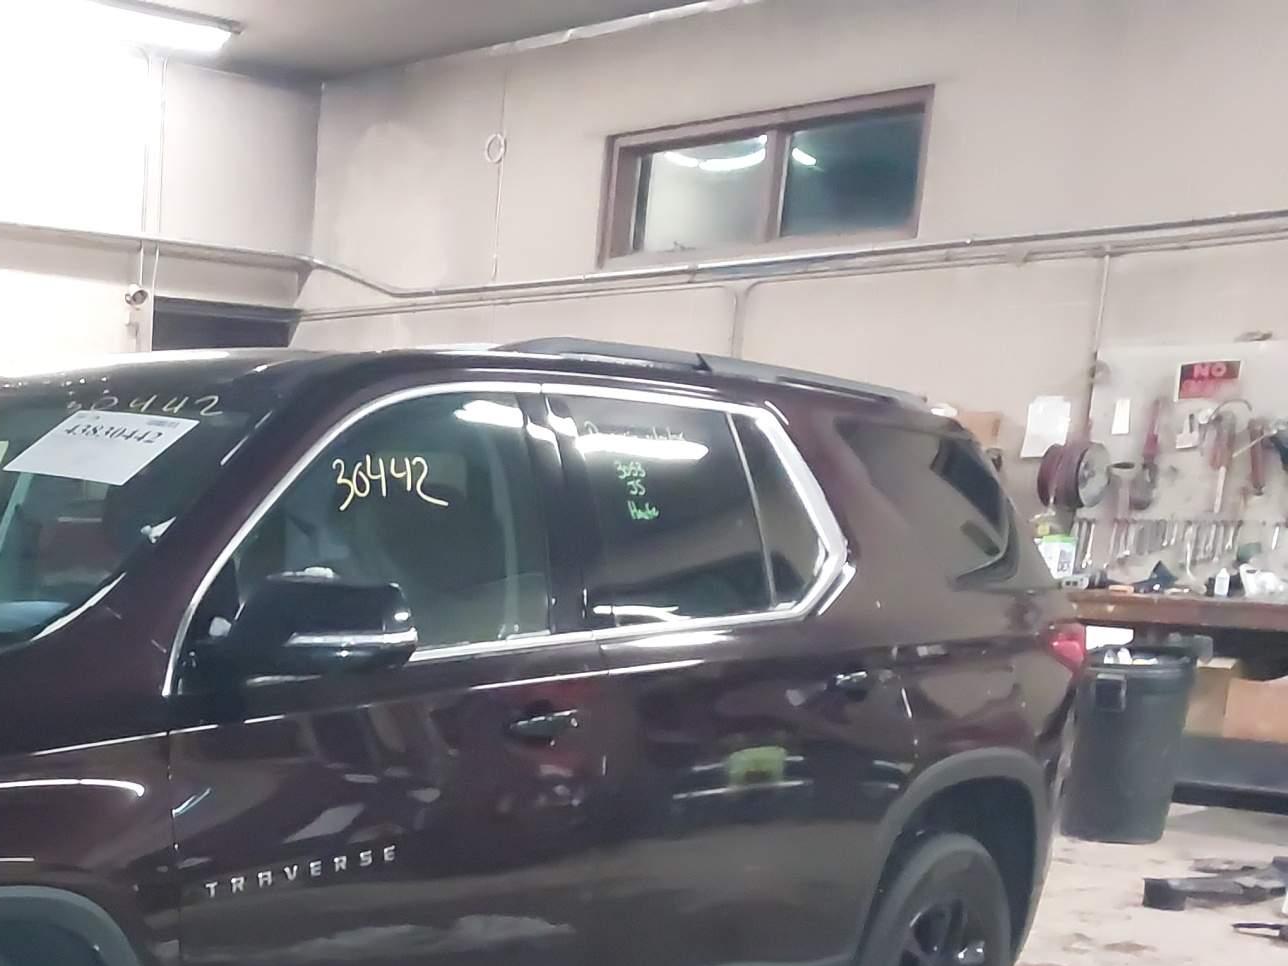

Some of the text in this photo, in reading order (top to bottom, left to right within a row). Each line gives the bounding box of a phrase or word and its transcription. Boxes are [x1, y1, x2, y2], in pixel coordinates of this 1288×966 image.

[65, 423, 162, 444] 43830442
[332, 454, 449, 511] 30442
[206, 845, 396, 897] TRAVERSE
